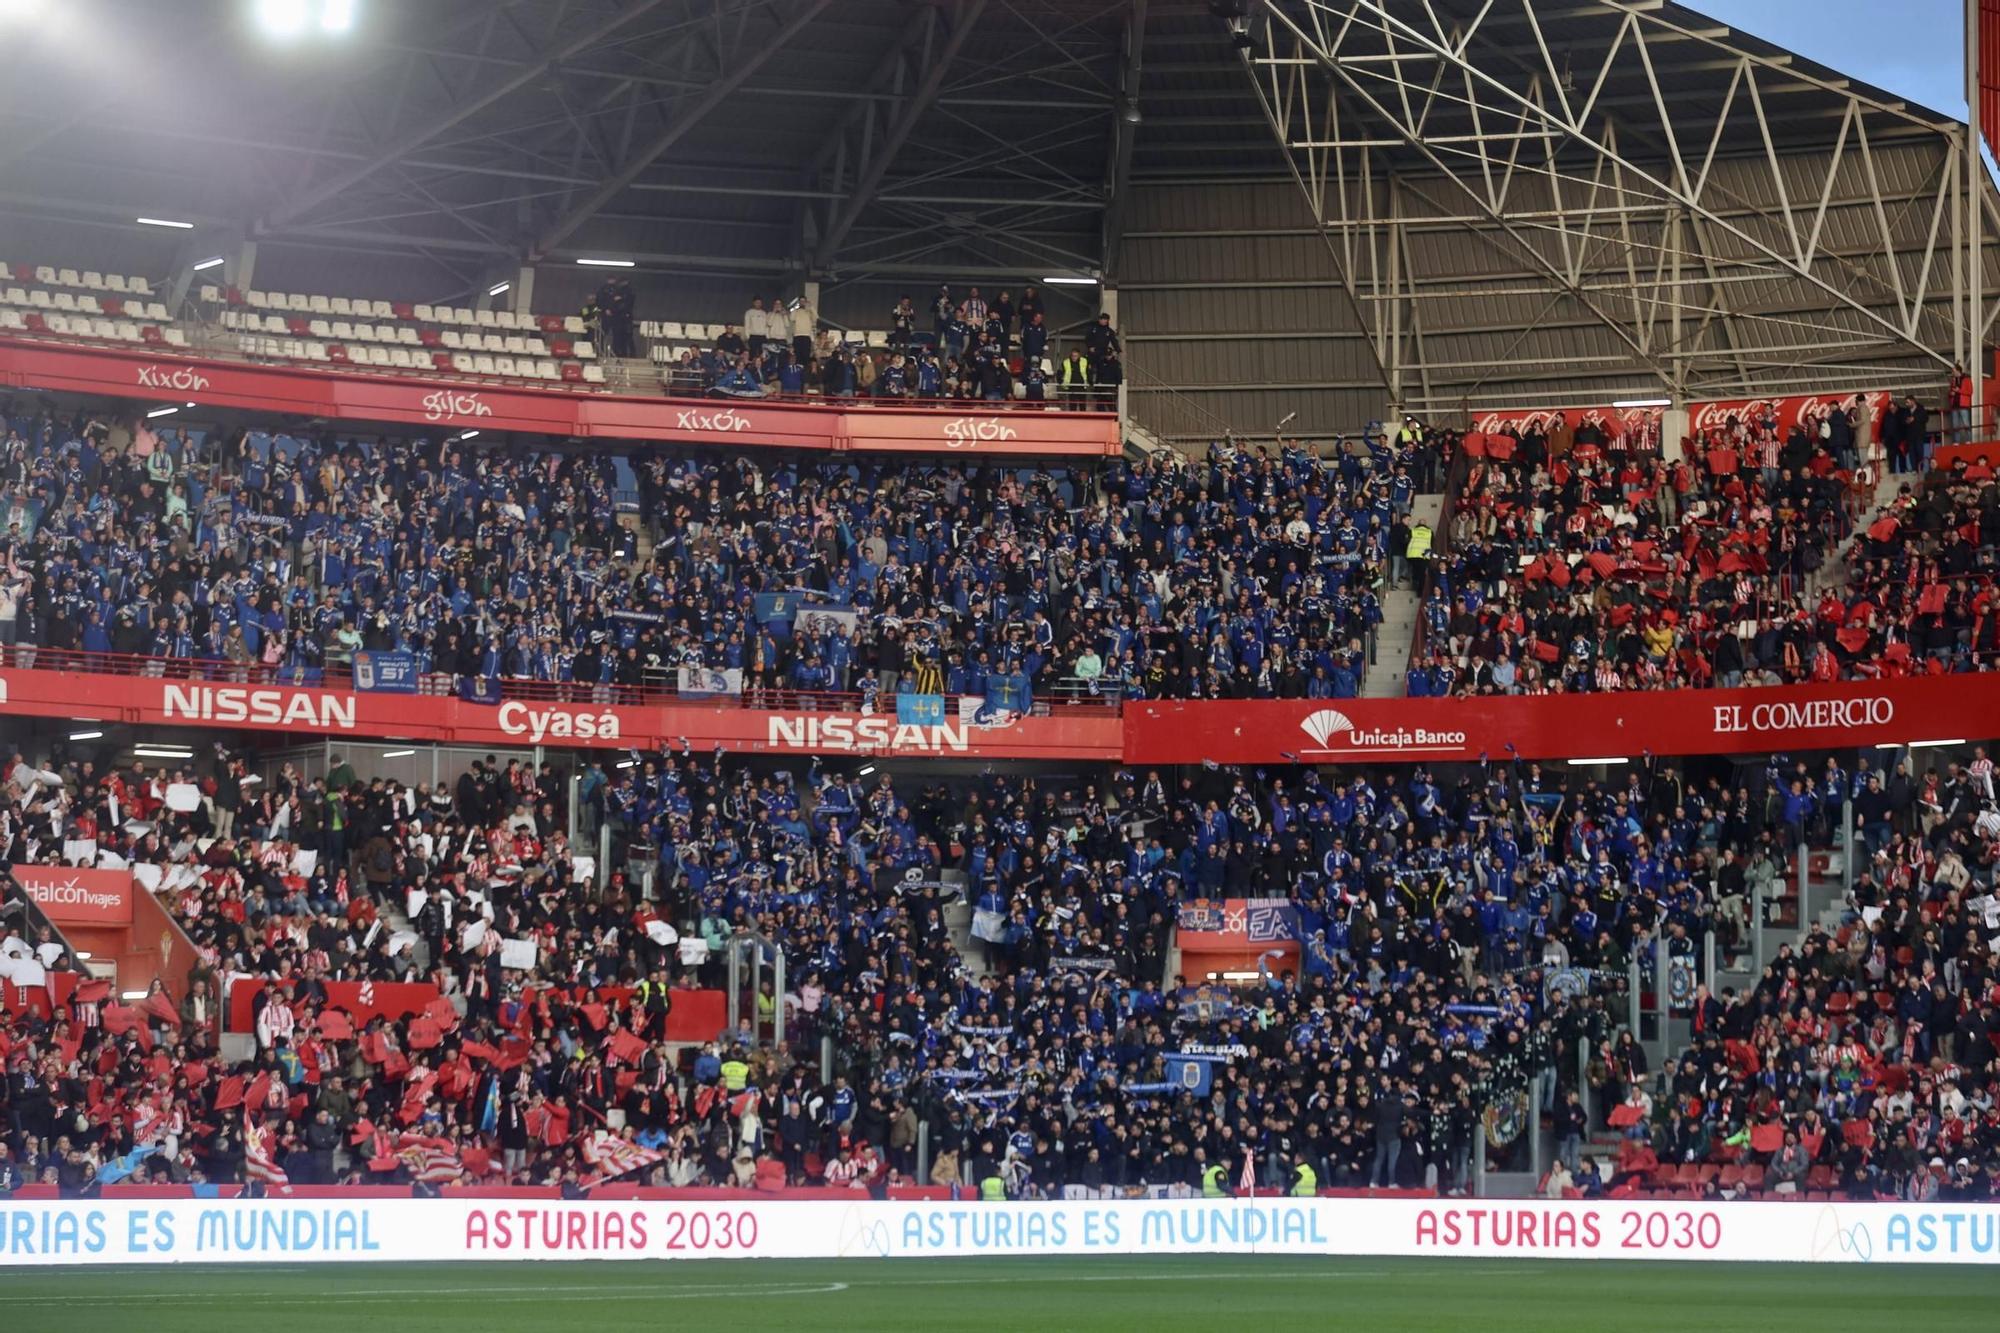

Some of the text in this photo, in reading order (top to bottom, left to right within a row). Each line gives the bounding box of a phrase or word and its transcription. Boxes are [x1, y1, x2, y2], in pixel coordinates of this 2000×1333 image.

[163, 684, 357, 728] NISSAN
[498, 701, 620, 743] Cyasa
[1713, 697, 1893, 732] EL COMERCIO
[769, 716, 968, 751] NISSAN
[1351, 728, 1466, 748] Unicaja Banco
[88, 892, 121, 909] viajes
[0, 1209, 380, 1254] RIAS ES MUNDIAL
[466, 1209, 758, 1250] ASTURIAS 2030
[903, 1207, 1327, 1248] ASTURIAS ES MUNDIAL
[1416, 1210, 1722, 1250] ASTURIAS 2030
